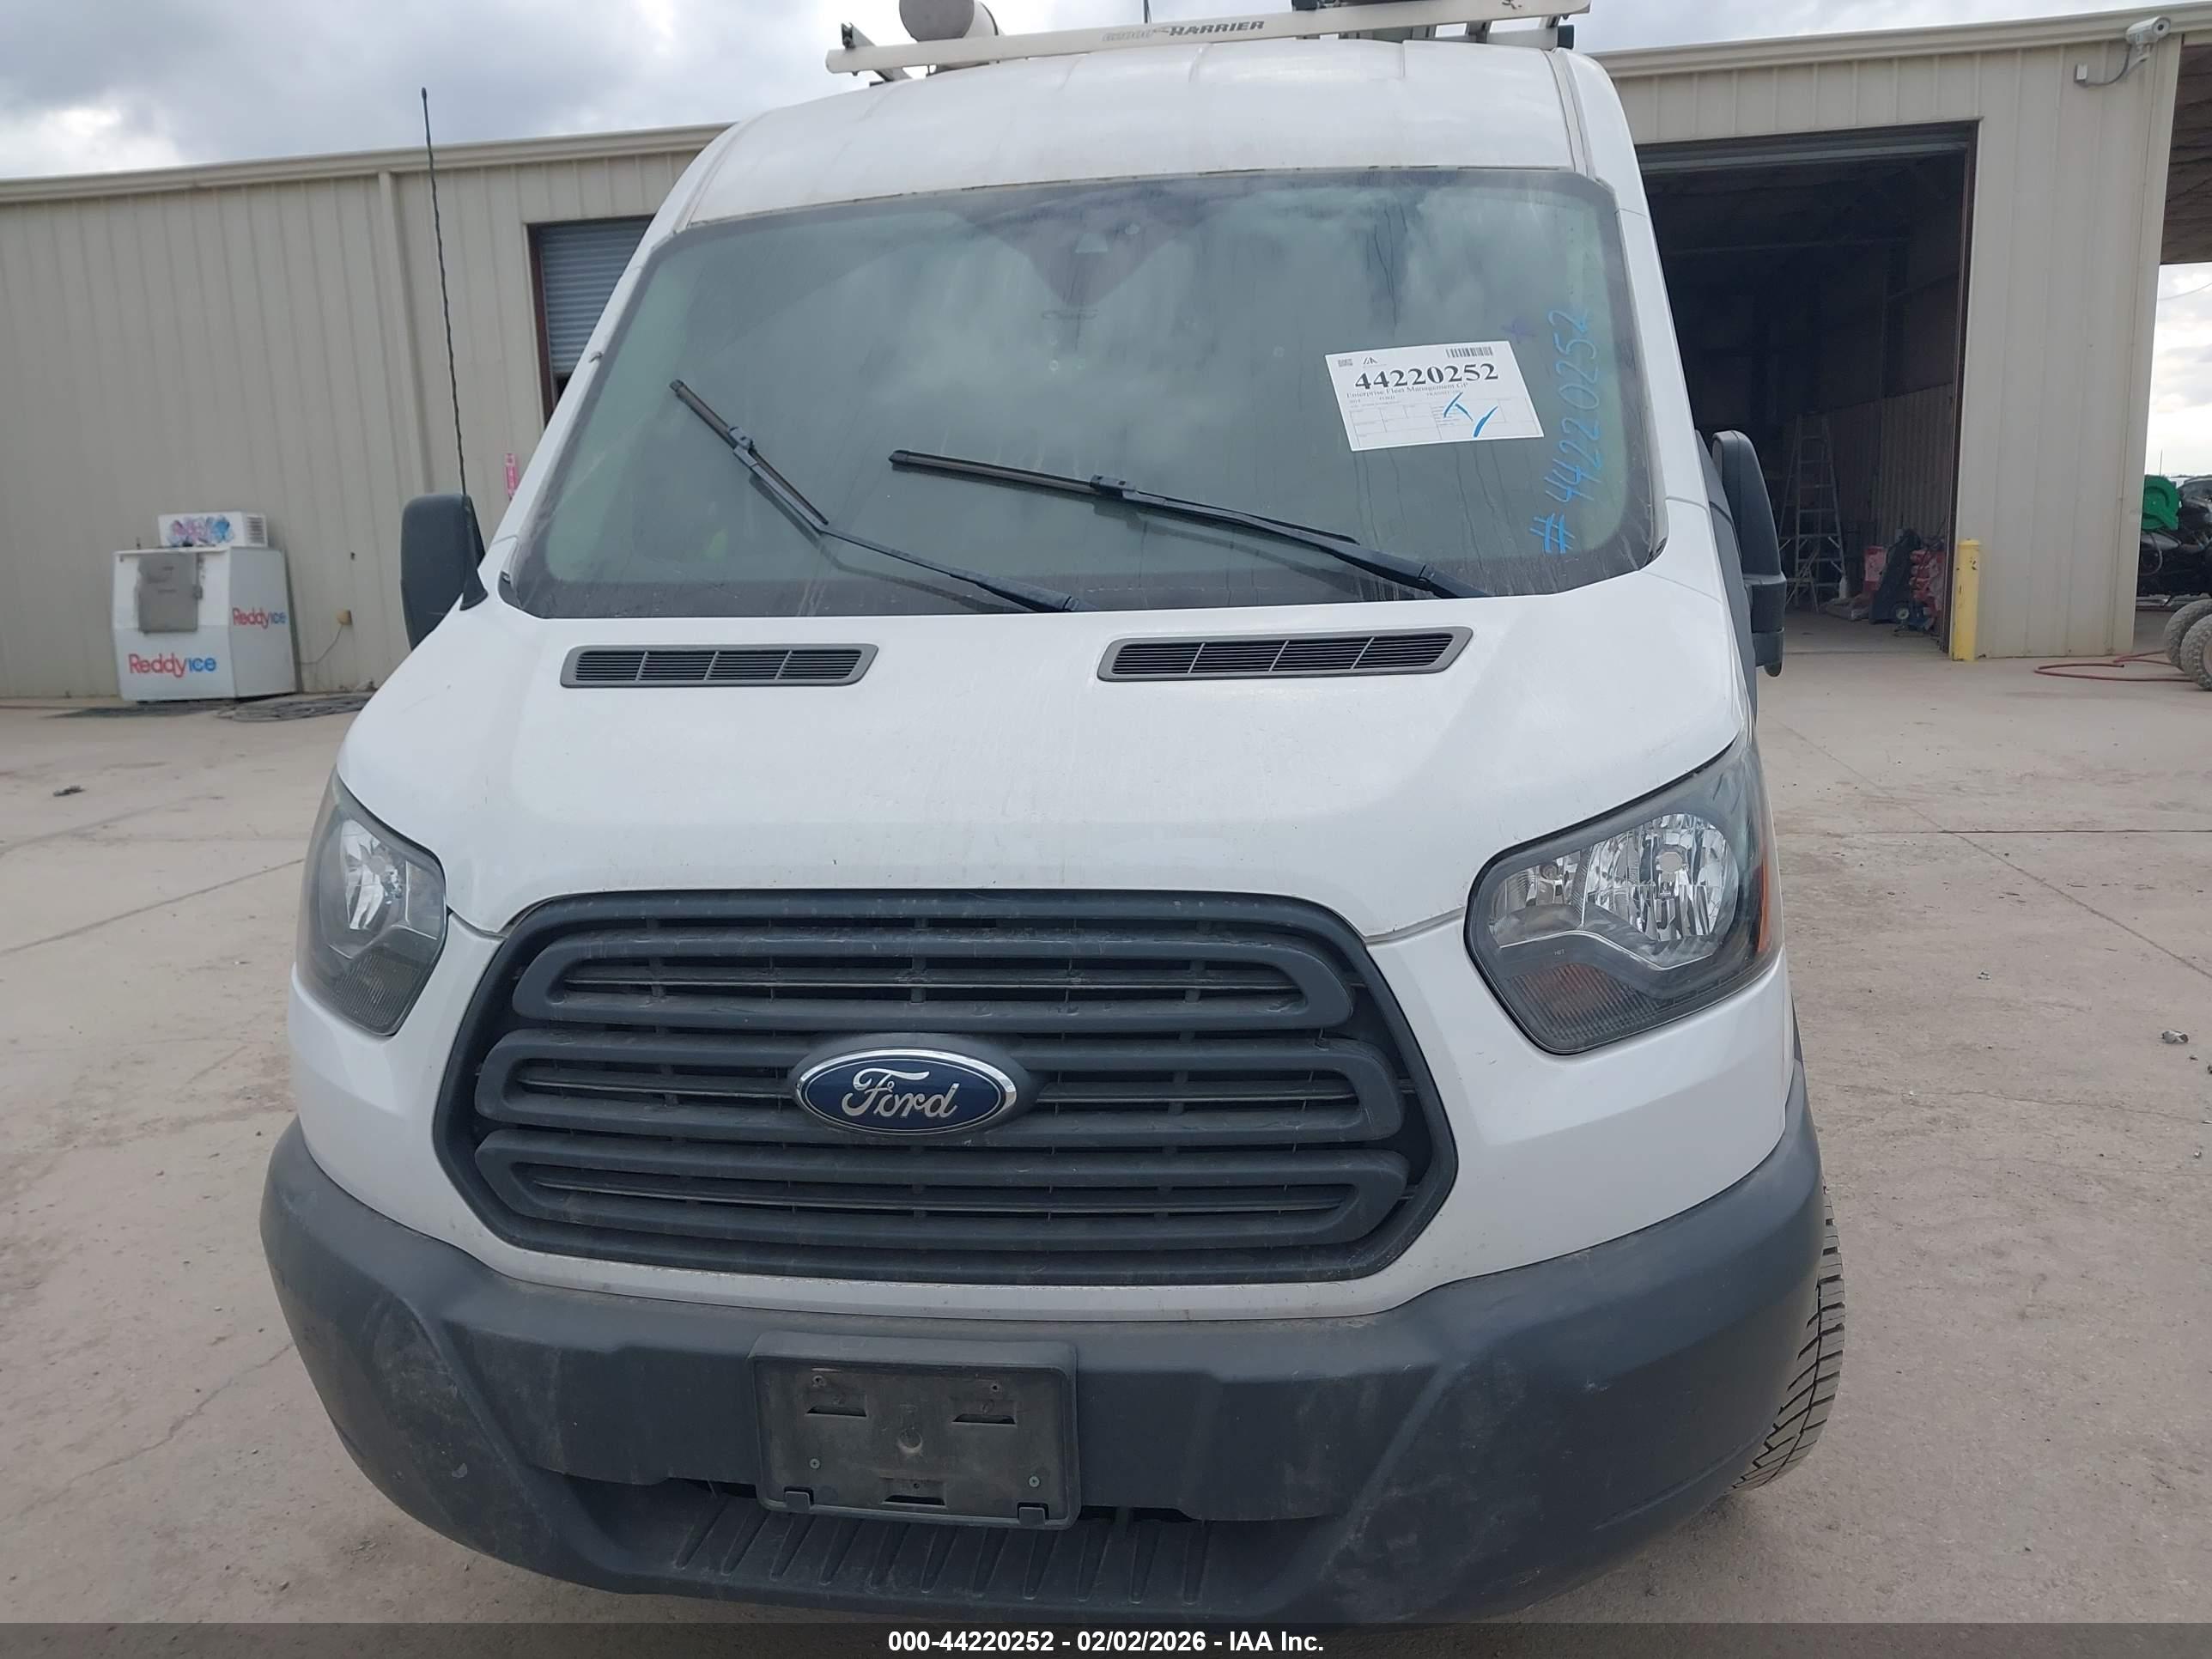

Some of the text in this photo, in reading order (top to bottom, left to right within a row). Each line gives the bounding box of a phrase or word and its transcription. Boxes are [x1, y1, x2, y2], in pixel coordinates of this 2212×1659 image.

[1169, 20, 1265, 37] HARRIER
[1355, 362, 1499, 390] 44220252
[841, 1067, 960, 1118] Ford
